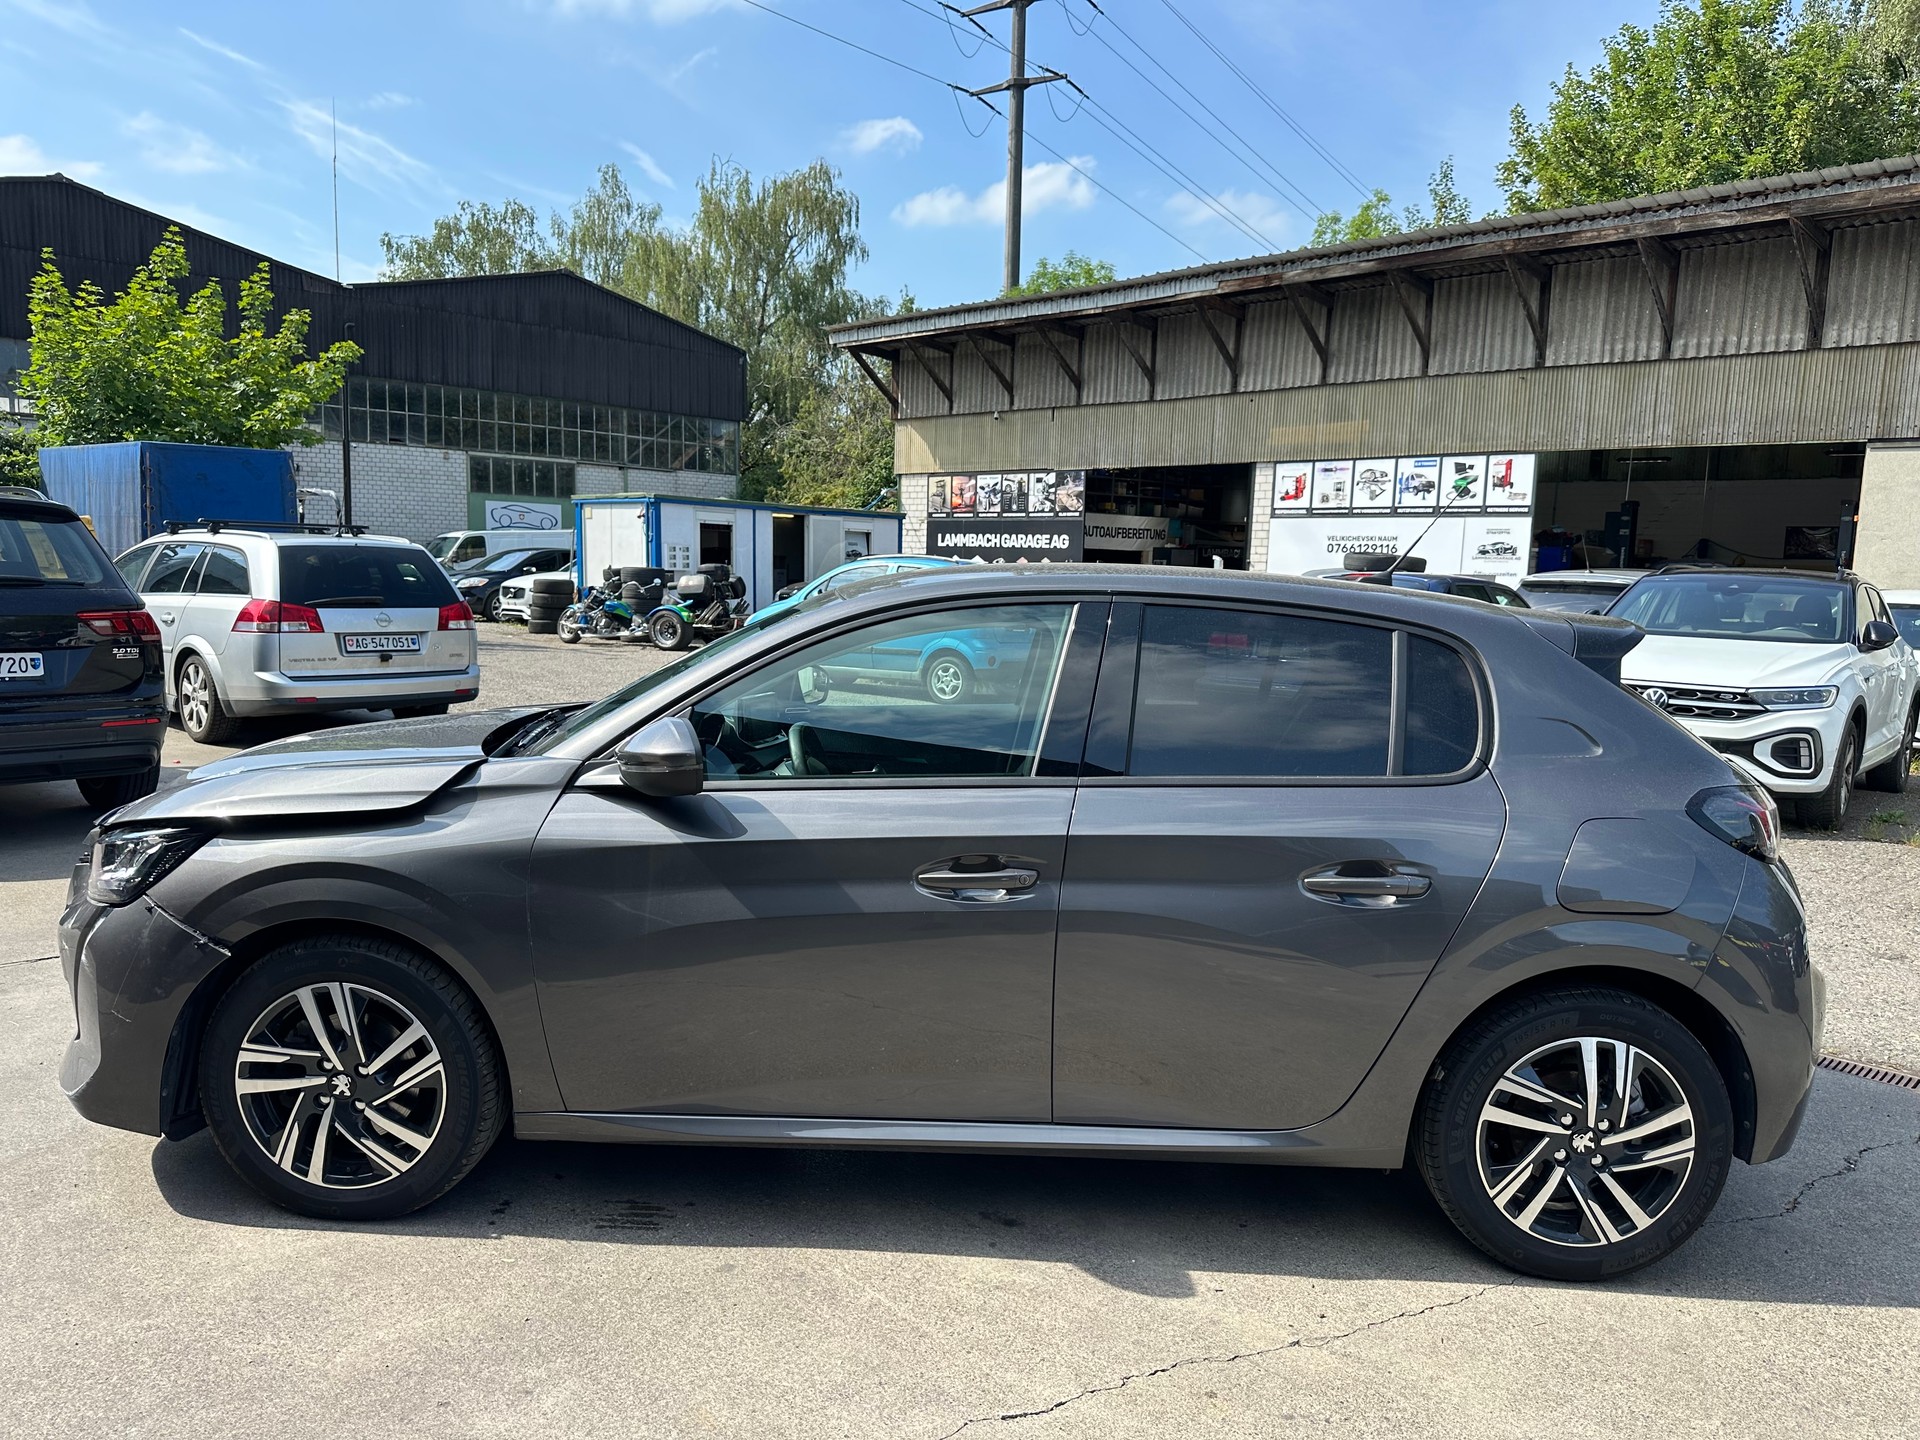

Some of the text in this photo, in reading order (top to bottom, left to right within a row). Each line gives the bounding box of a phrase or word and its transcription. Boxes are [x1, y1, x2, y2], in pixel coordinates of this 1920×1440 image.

[937, 533, 1070, 549] LAMMBACH GARAGE AG
[1084, 525, 1166, 541] AUTOAUFBEREITUNG
[1326, 543, 1398, 554] 0766129116
[1455, 1046, 1505, 1126] MICHELIN
